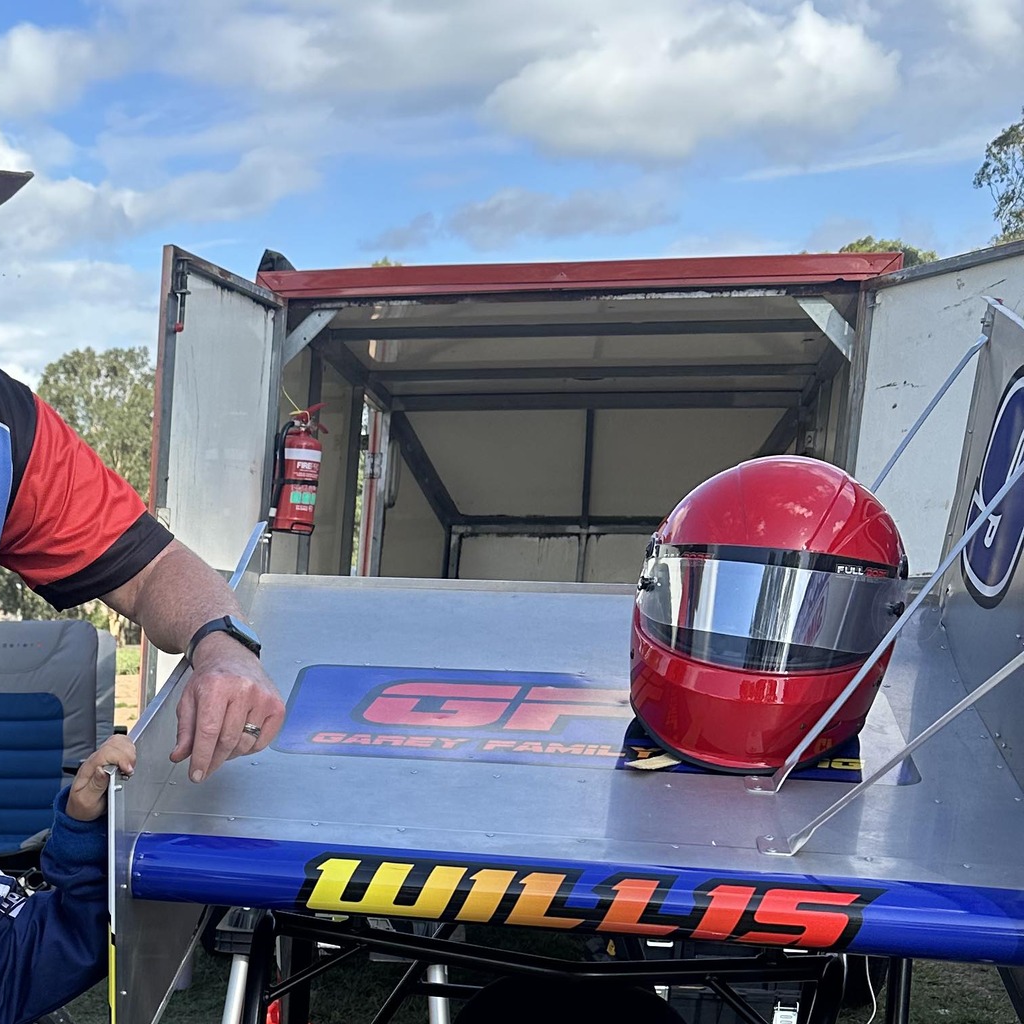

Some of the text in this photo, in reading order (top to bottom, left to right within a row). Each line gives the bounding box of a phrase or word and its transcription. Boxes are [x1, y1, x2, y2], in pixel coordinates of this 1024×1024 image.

[837, 565, 864, 576] FULL
[362, 681, 635, 732] GF
[311, 731, 657, 760] GAREY FAMILY
[304, 856, 864, 949] WILLIS
